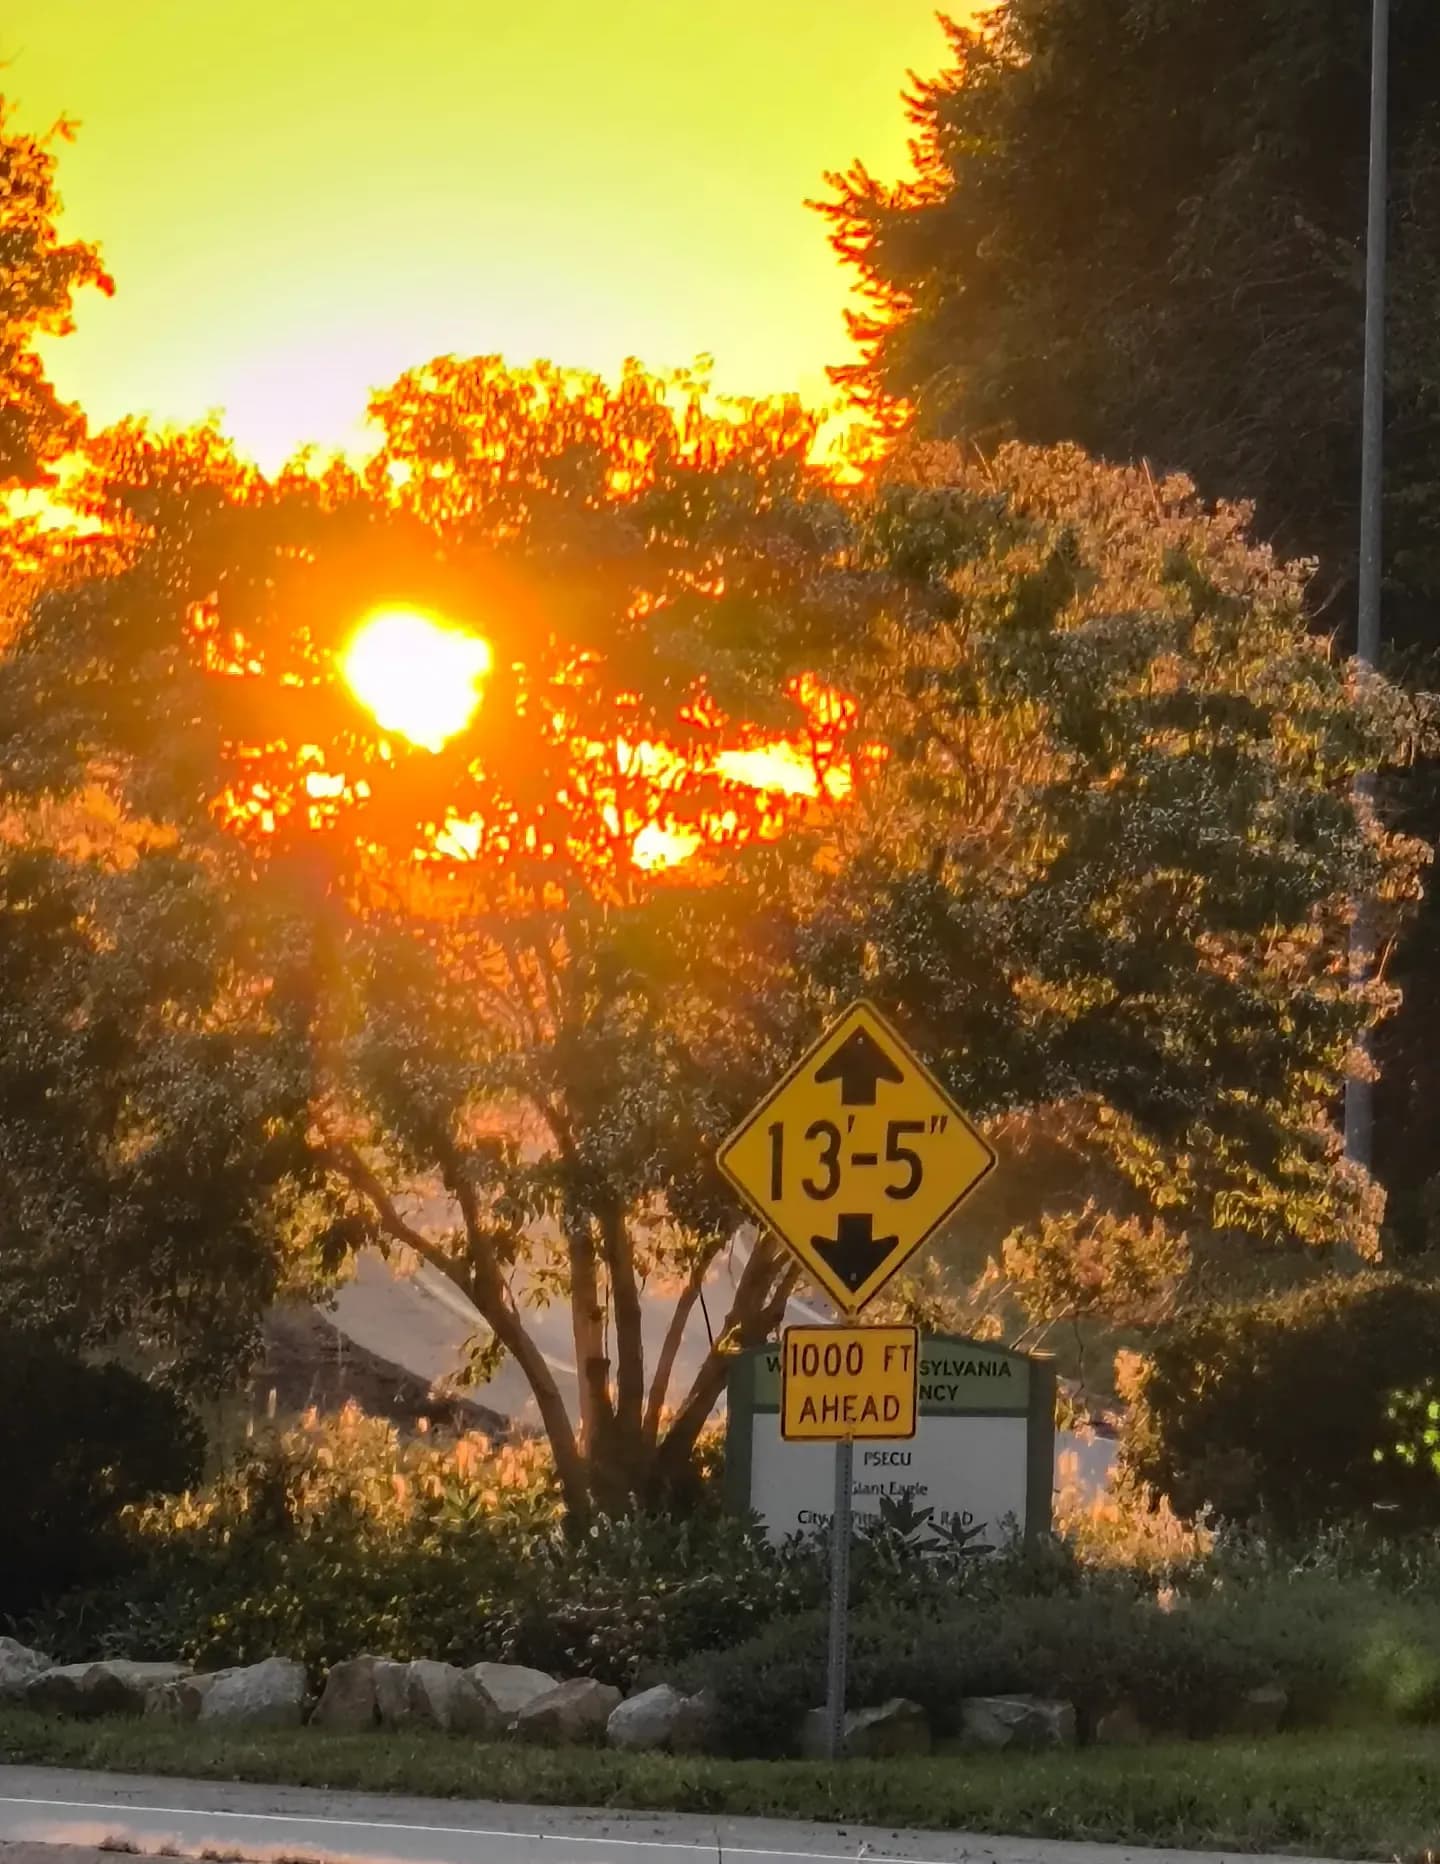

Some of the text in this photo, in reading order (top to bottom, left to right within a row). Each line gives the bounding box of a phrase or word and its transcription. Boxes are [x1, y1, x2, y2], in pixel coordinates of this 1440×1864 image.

[767, 1114, 949, 1202] 13'-5"
[791, 1342, 864, 1377] 1000
[883, 1344, 912, 1373] FT
[919, 1358, 1012, 1378] SYLVANIA
[798, 1394, 900, 1425] AHEAD
[863, 1451, 912, 1467] PSECU
